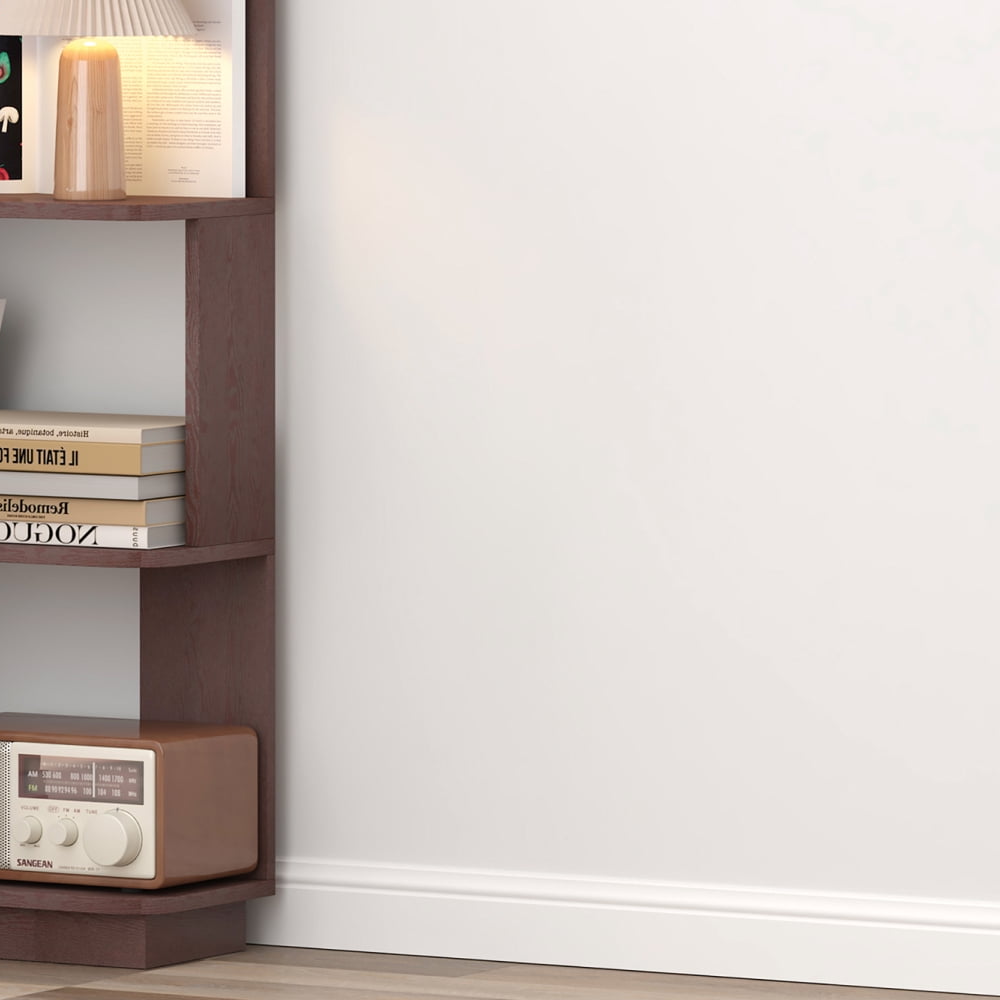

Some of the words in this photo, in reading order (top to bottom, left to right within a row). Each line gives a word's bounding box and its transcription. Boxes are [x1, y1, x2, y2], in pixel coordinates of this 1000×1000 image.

[27, 770, 38, 778] AM
[28, 784, 38, 792] FM
[16, 858, 53, 868] SANGEAN
